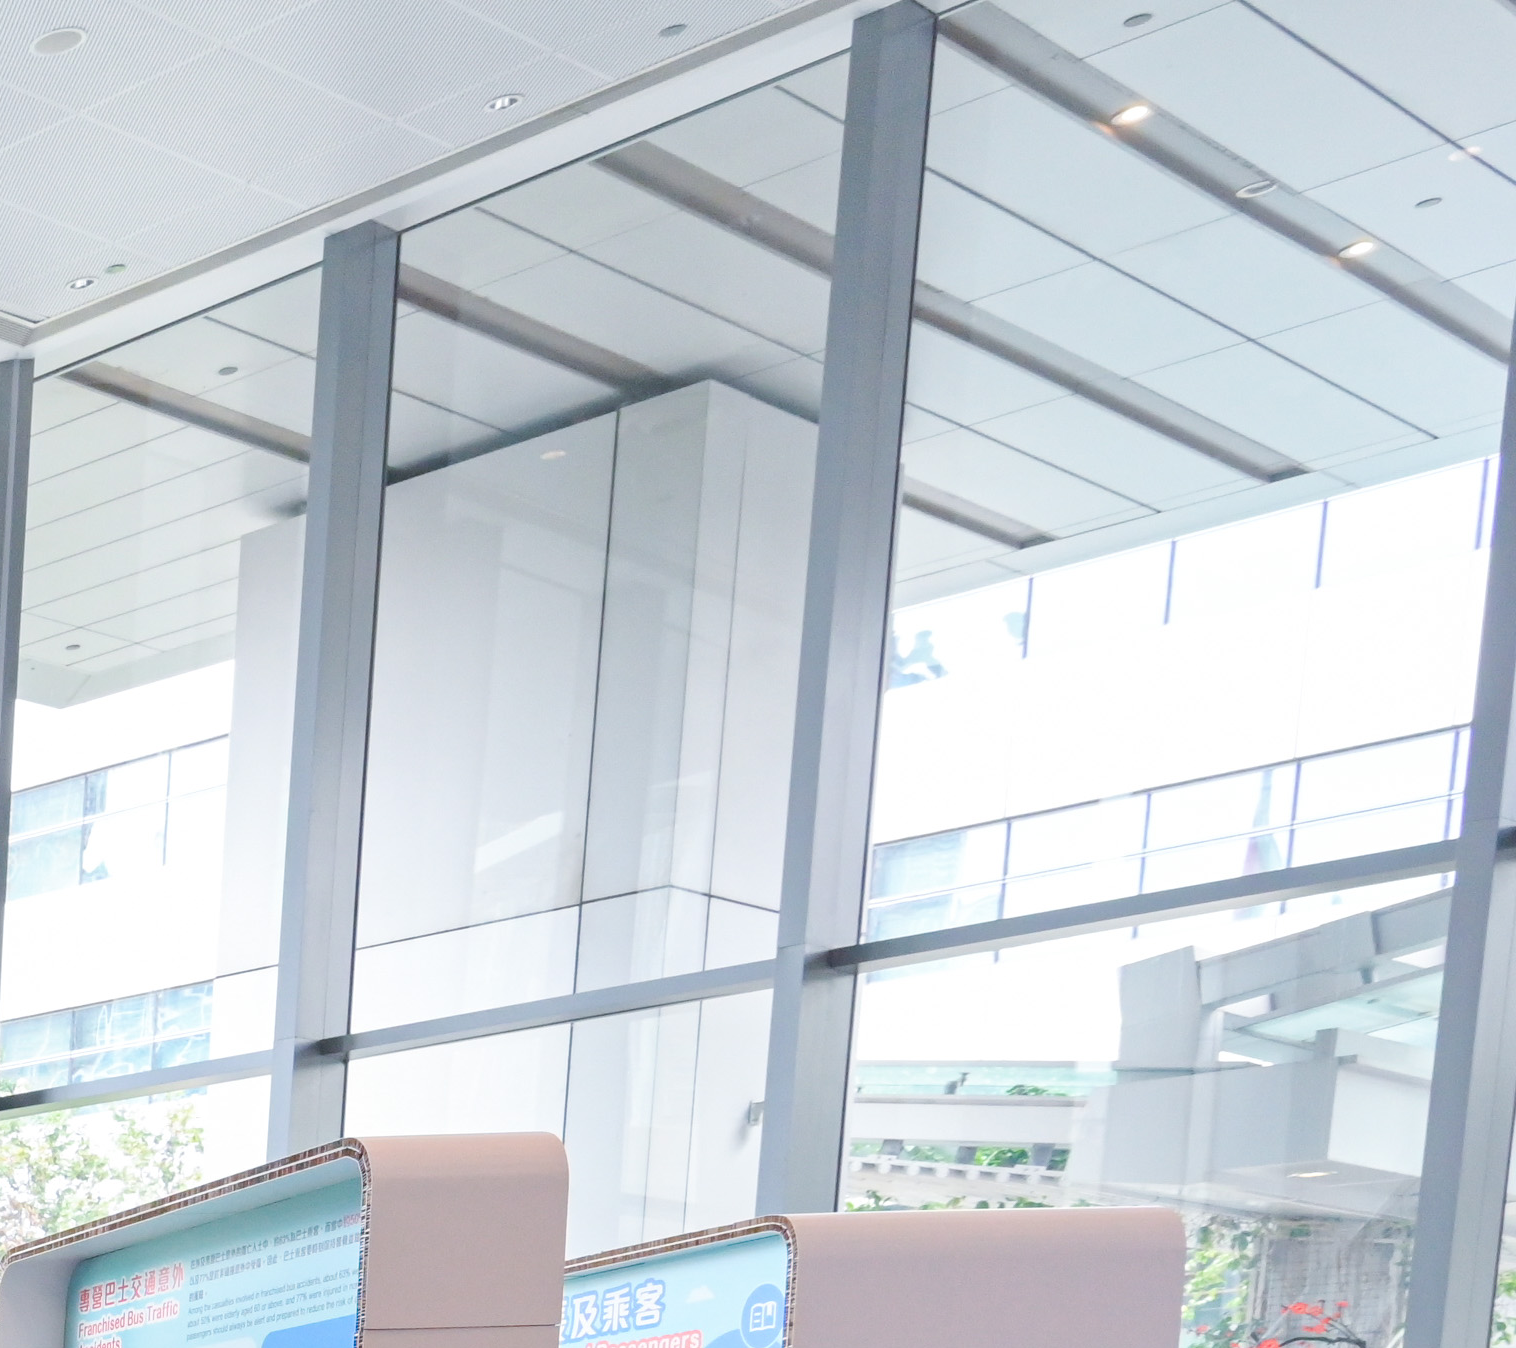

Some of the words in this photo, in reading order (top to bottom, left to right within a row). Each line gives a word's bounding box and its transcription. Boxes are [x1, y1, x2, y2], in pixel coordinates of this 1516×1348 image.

[78, 1262, 184, 1312] 專營巴士交通意外
[78, 1311, 125, 1339] Franchised
[128, 1308, 144, 1327] Bus
[146, 1300, 179, 1322] Traffic
